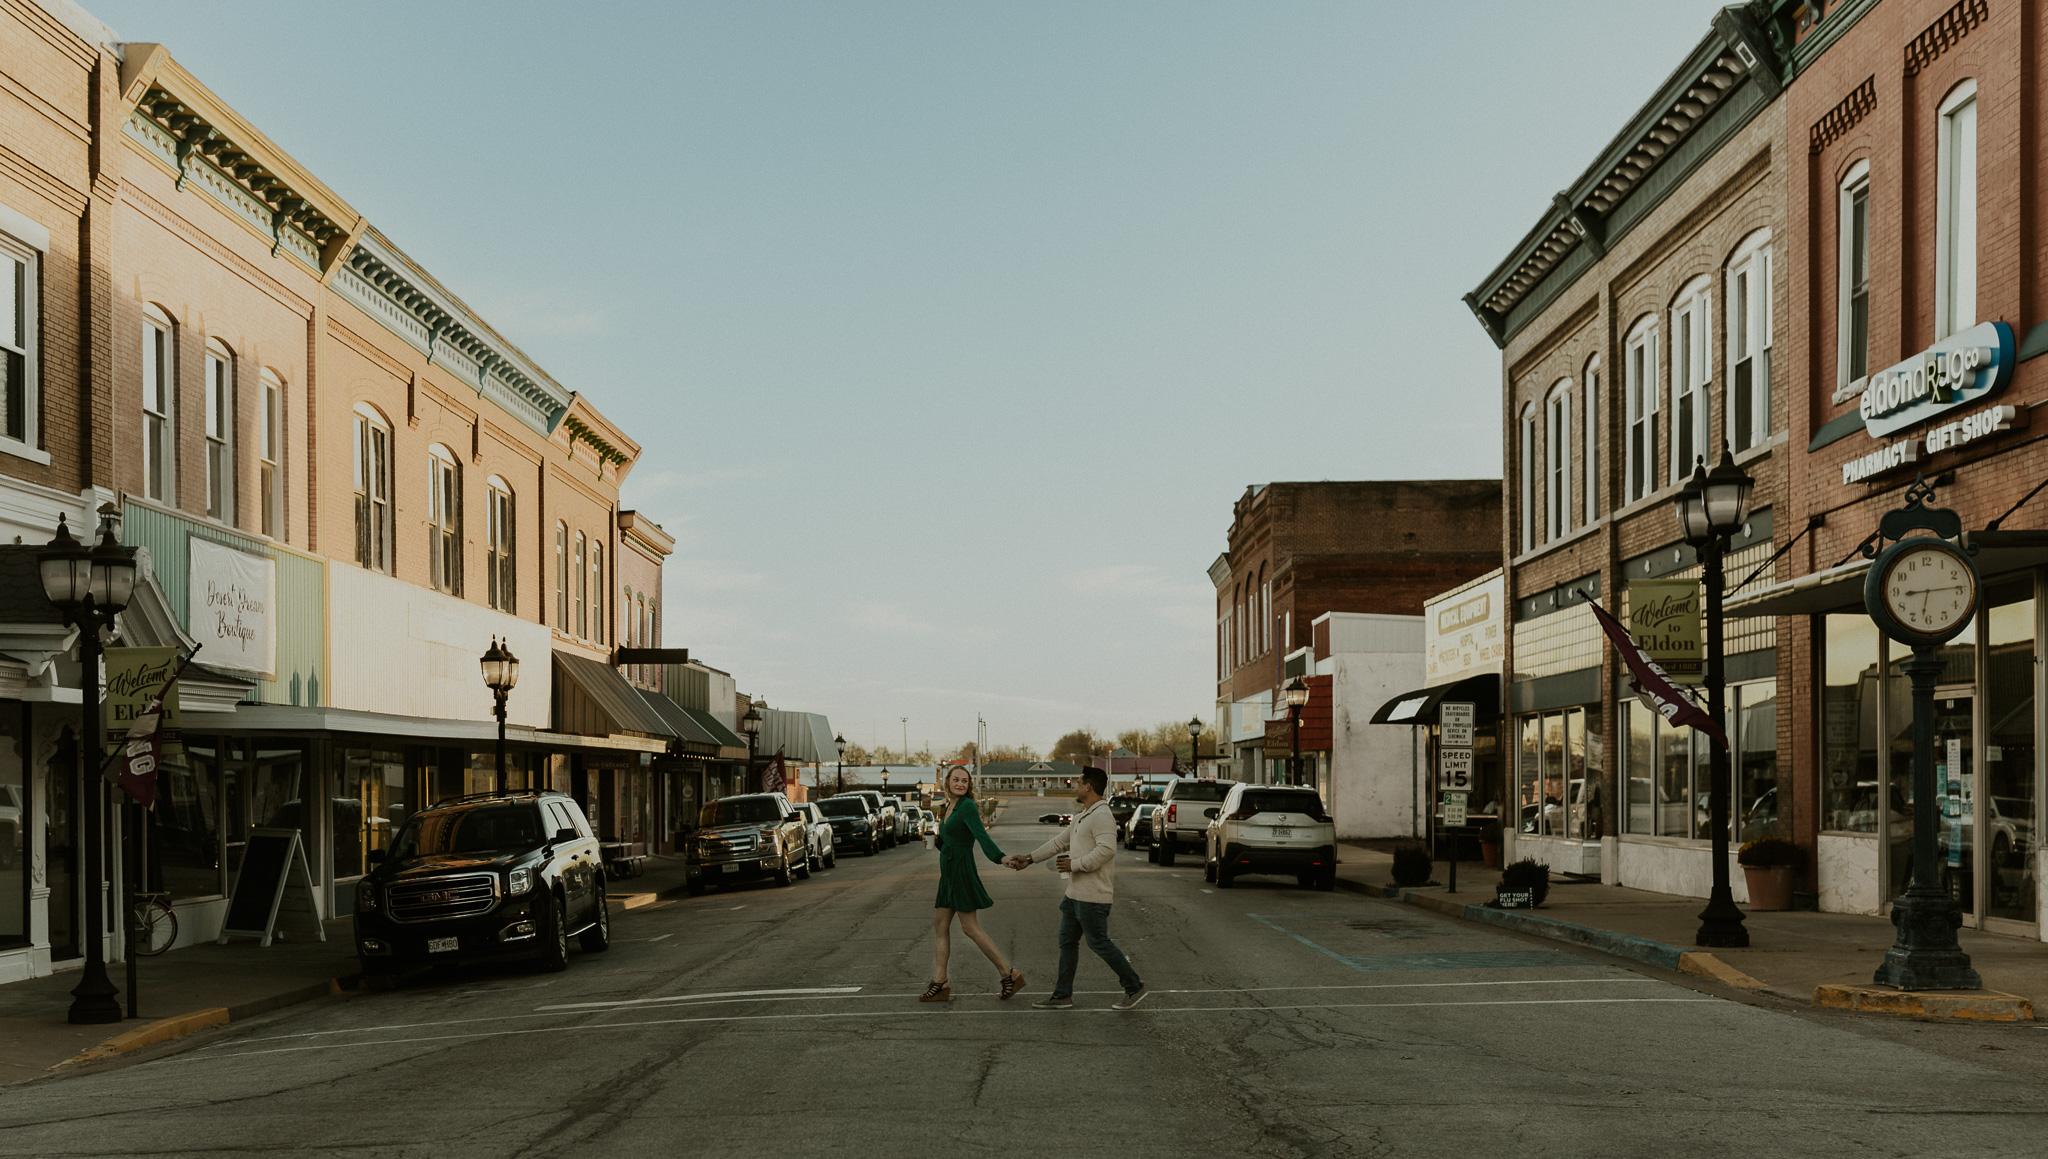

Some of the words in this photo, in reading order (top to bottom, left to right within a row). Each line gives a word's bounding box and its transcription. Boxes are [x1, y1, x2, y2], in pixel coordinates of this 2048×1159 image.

[1926, 423, 1959, 455] GIFT
[1962, 405, 2004, 442] SHOP
[1842, 440, 1908, 485] PHARMACY
[1908, 561, 1916, 571] 11
[1921, 557, 1932, 567] 12
[1940, 560, 1944, 570] 1
[1897, 572, 1907, 582] 10
[1950, 571, 1958, 580] 2
[1892, 588, 1900, 597] 9
[1631, 590, 1699, 628] Welcome
[1898, 602, 1906, 612] 8
[1952, 600, 1959, 610] 4
[1909, 613, 1917, 622] 7
[1925, 615, 1932, 625] 6
[1940, 611, 1948, 621] 5
[215, 610, 256, 652] Boutique
[1668, 624, 1681, 633] to
[1639, 635, 1695, 651] Eldon
[108, 657, 177, 698] Welcome
[144, 693, 158, 701] to
[114, 704, 173, 721] Eldn
[1446, 771, 1467, 787] 15
[1445, 794, 1451, 804] 2
